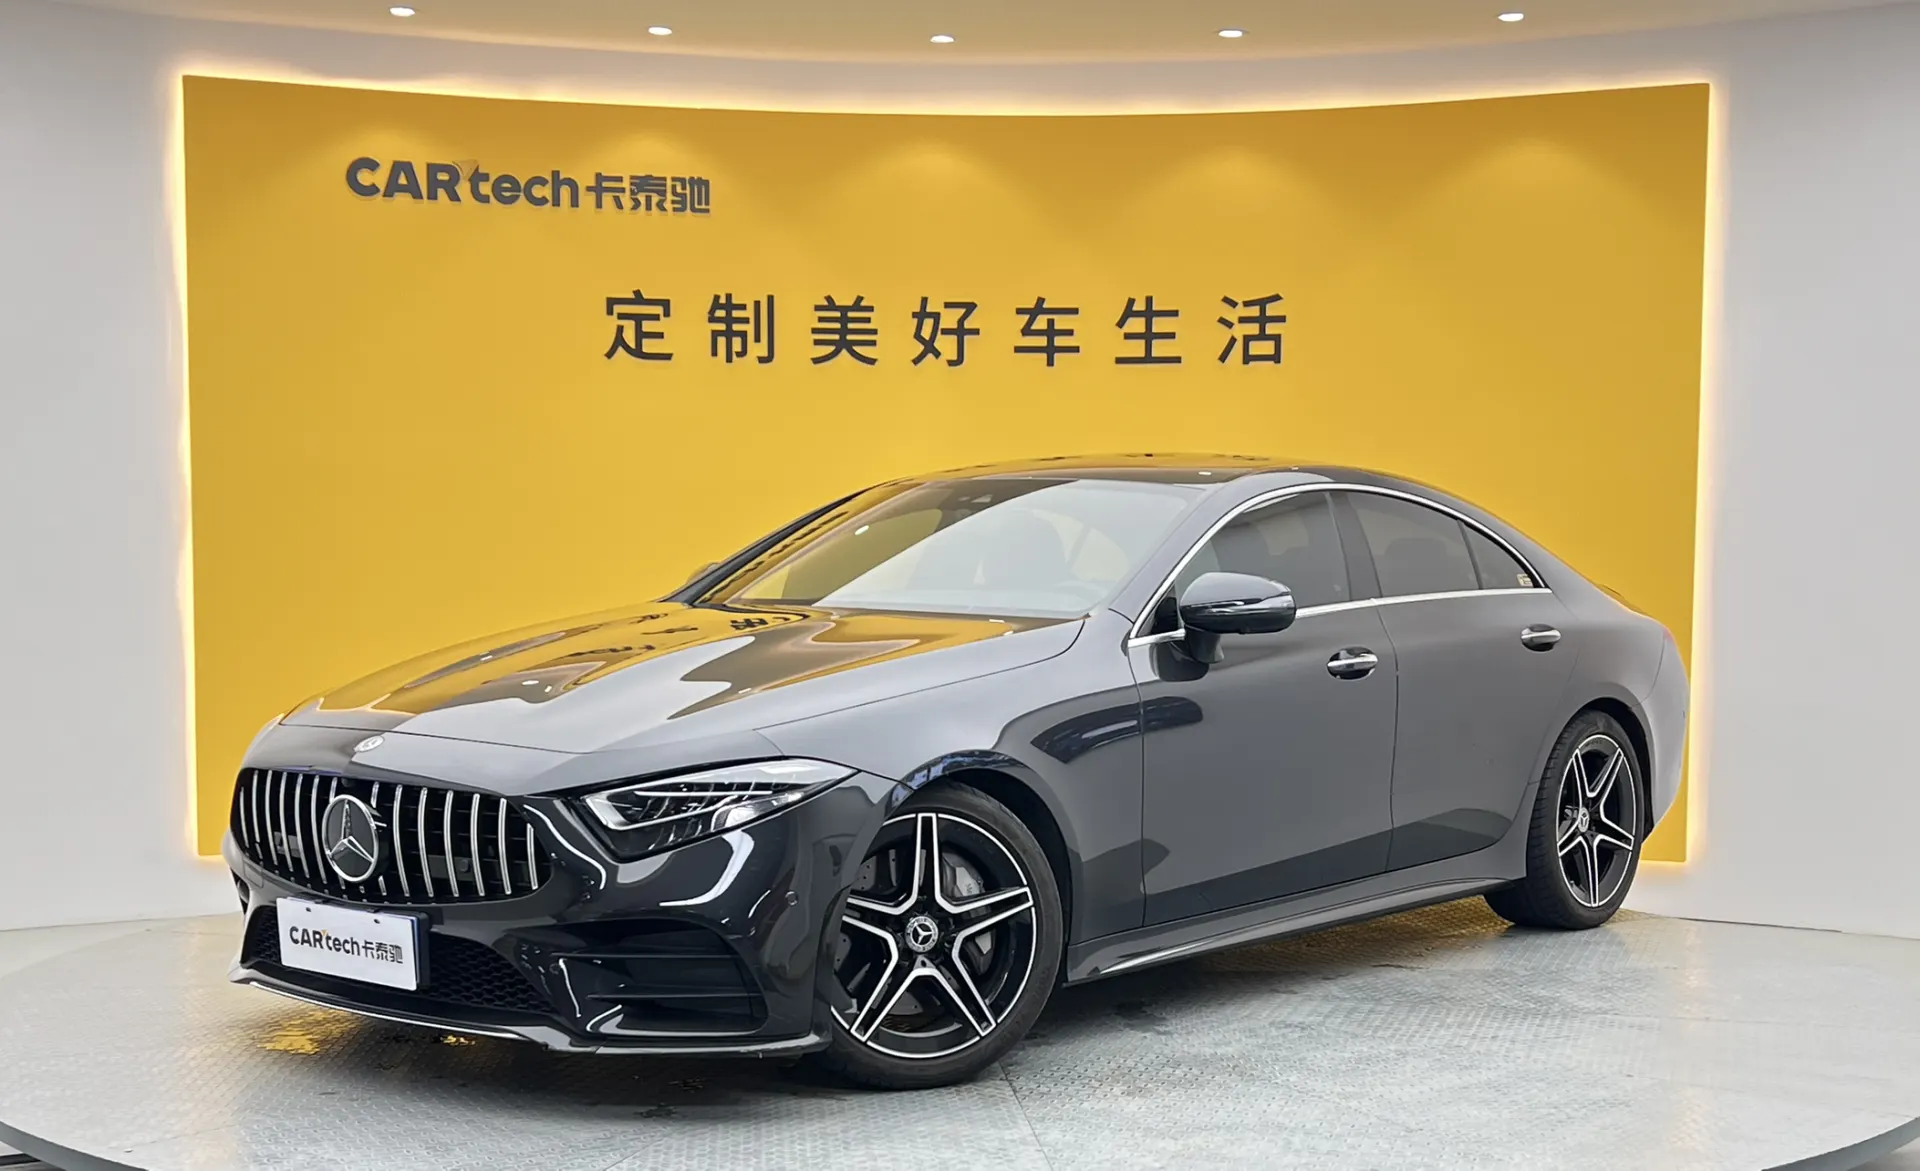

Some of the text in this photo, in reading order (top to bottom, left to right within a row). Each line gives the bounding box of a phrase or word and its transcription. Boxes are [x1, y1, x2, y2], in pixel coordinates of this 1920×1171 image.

[346, 157, 710, 213] CARtech 卡泰驰
[603, 290, 1287, 367] 定制美好车生活
[289, 926, 361, 956] CARtech
